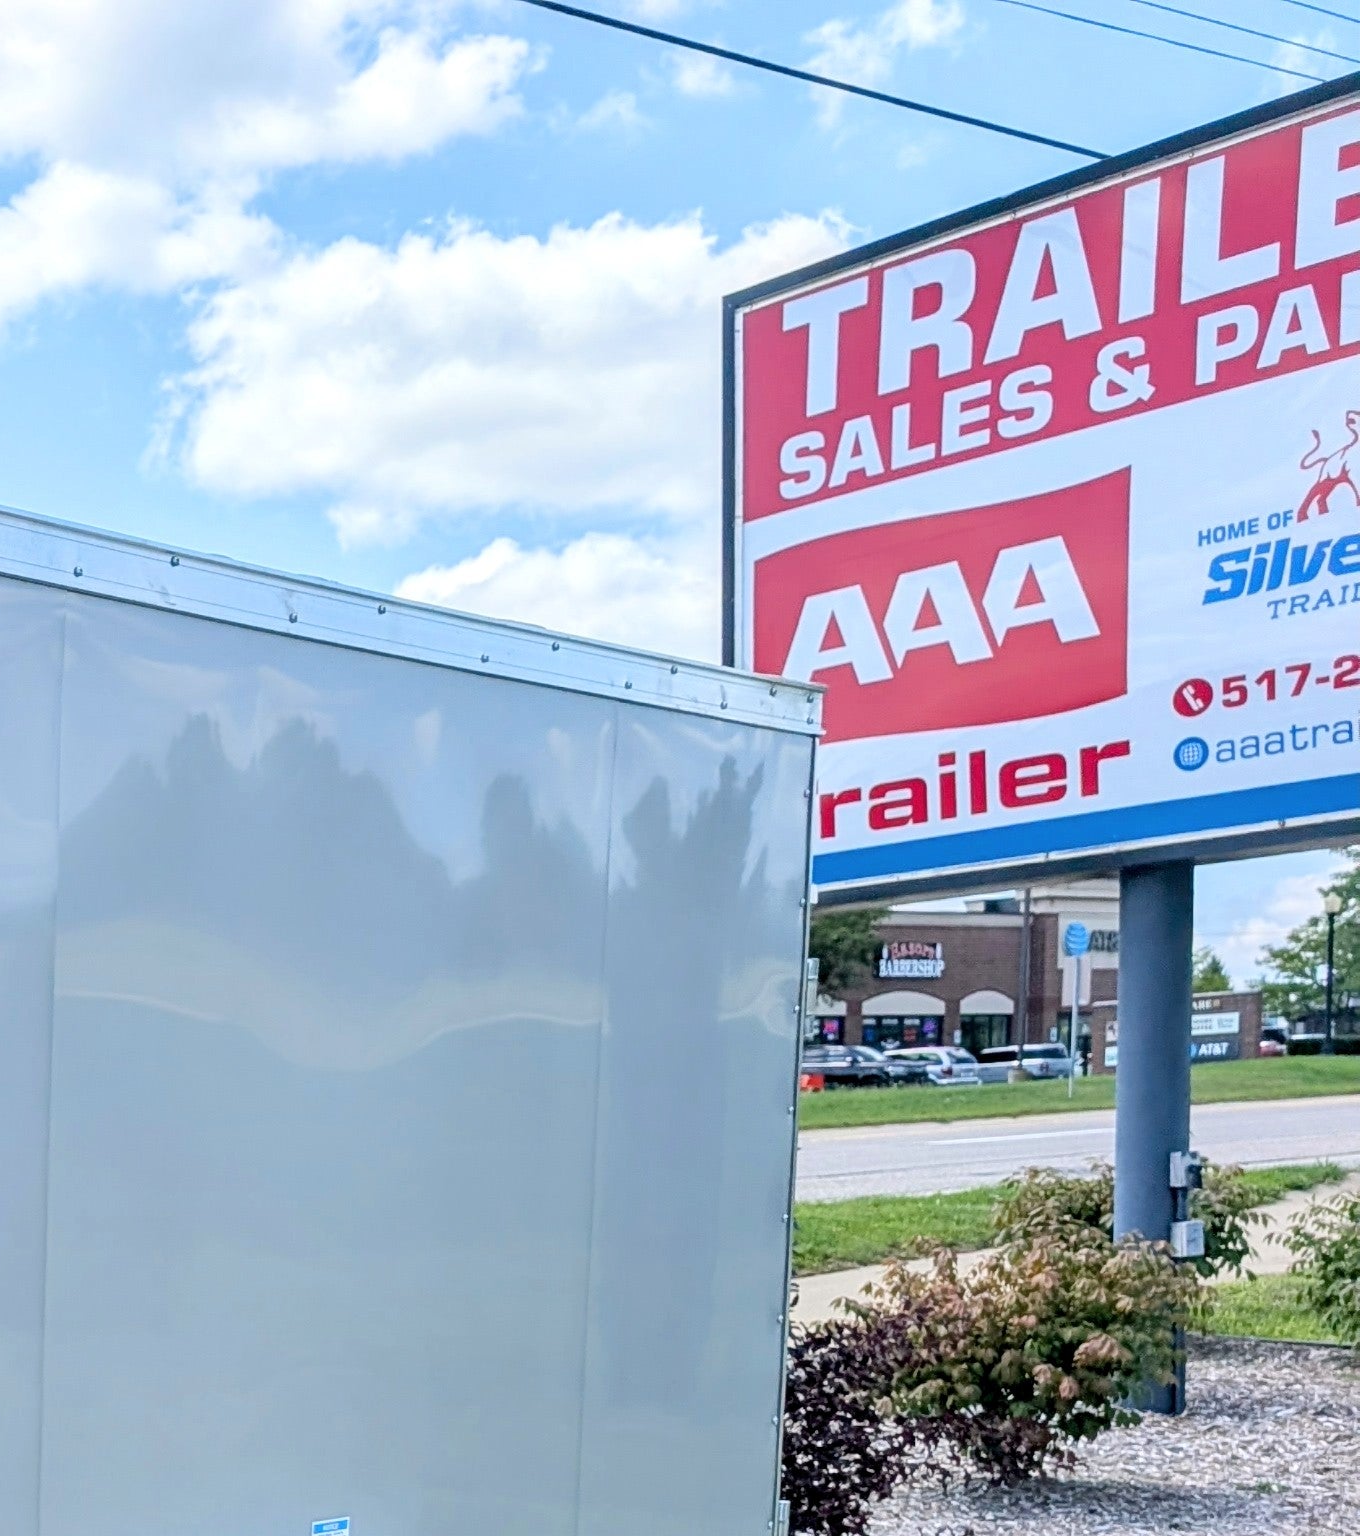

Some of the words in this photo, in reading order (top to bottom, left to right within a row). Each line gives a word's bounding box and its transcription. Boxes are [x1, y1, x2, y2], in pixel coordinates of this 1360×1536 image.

[779, 362, 1054, 501] SALES
[1088, 336, 1156, 412] &
[1197, 516, 1260, 548] HOME
[1266, 509, 1294, 532] OF
[781, 535, 1102, 686] AAA
[1215, 712, 1360, 763] aaatra
[817, 739, 1131, 839] railer
[1198, 1042, 1230, 1057] AT&T
